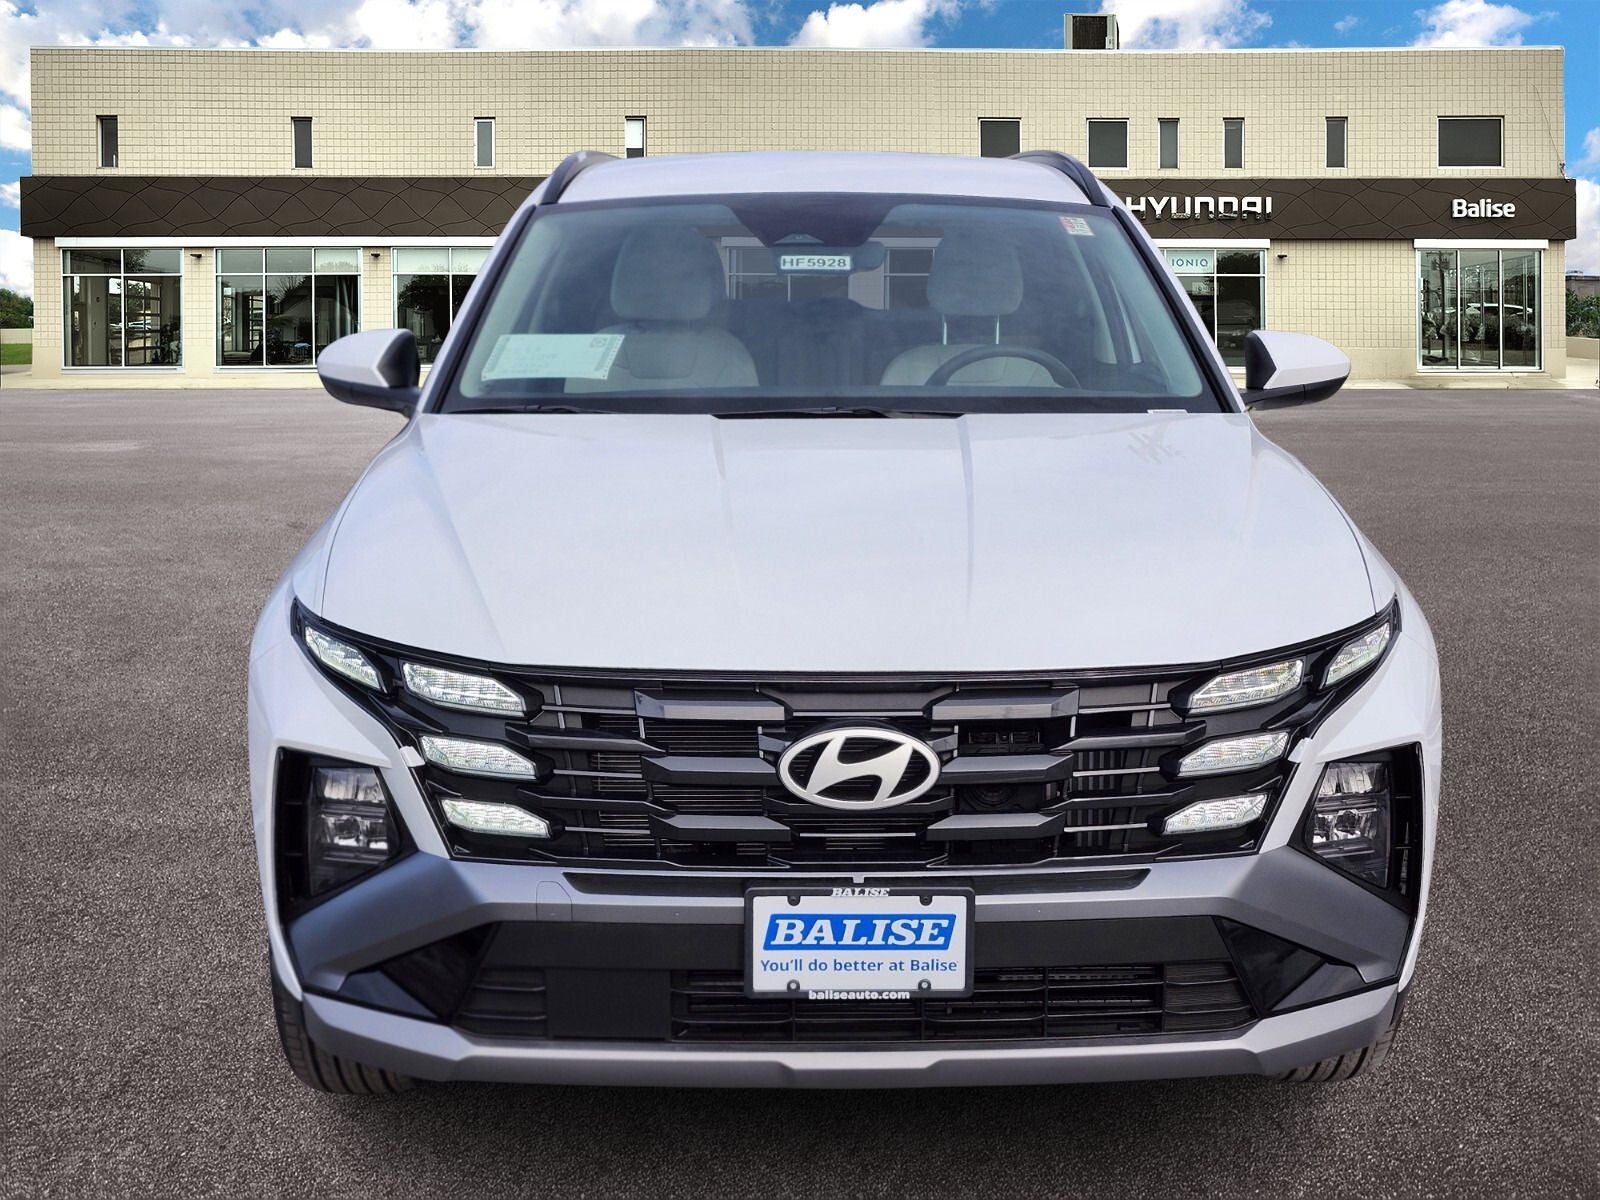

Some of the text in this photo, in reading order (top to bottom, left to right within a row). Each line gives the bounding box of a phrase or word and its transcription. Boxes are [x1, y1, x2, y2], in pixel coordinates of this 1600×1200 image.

[1125, 196, 1273, 220] HYUNDAI
[1452, 198, 1516, 218] Balise
[782, 257, 847, 268] HF5928
[1171, 258, 1209, 268] IONIQ
[830, 887, 891, 898] BALISE
[769, 918, 950, 946] BALISE
[808, 958, 828, 972] do
[833, 958, 884, 972] better
[888, 960, 905, 972] at
[910, 958, 958, 972] Balise
[808, 989, 911, 1000] baliseauto.com
